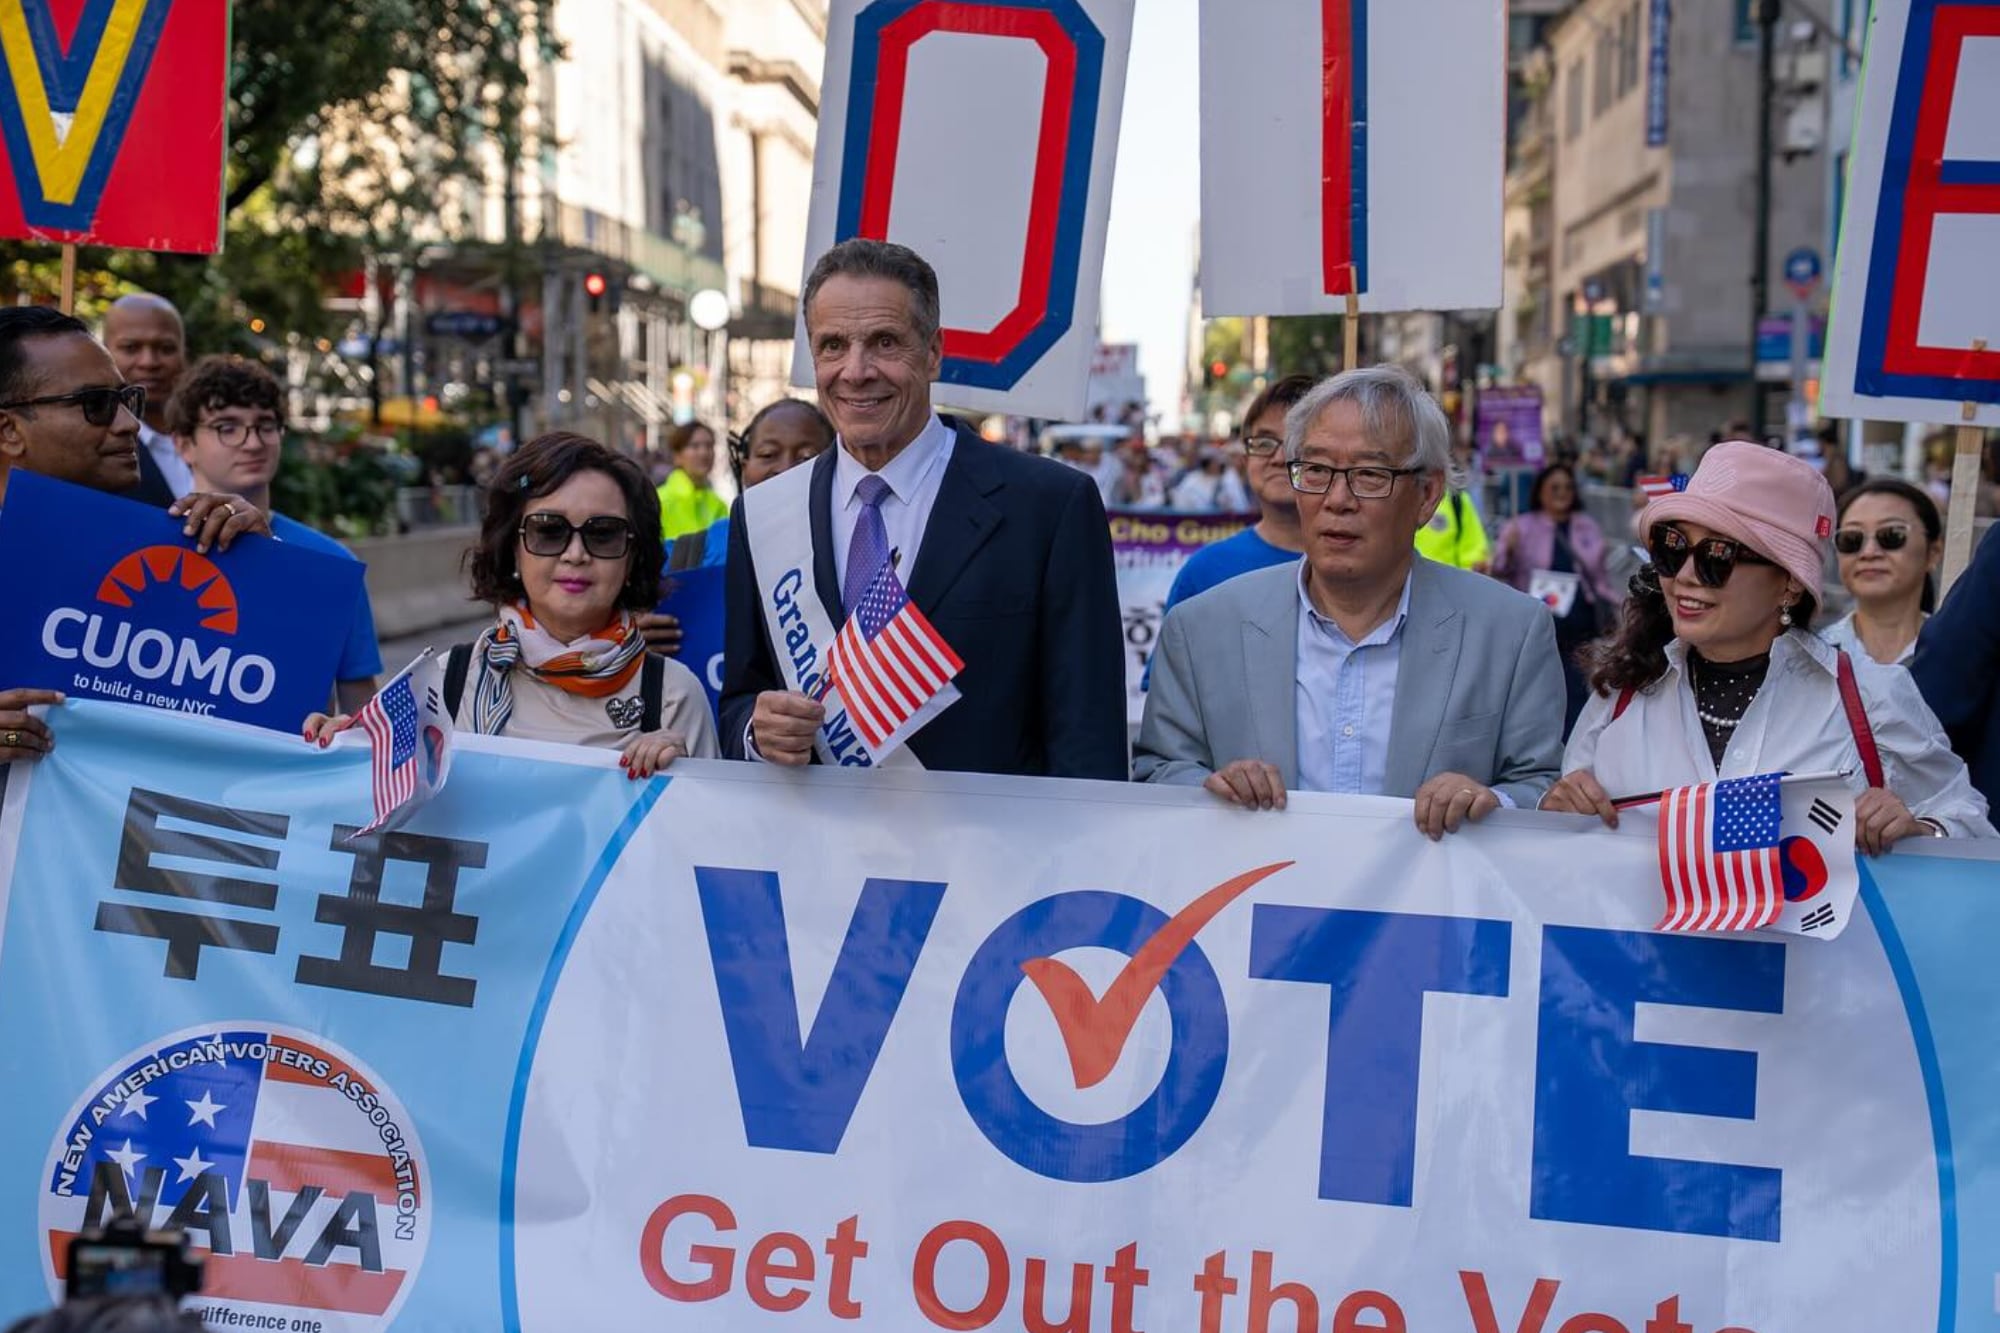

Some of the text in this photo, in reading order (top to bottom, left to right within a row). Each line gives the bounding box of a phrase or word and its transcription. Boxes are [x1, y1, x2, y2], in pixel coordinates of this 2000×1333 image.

[42, 607, 276, 704] CUOMO
[73, 673, 216, 717] to build a new NYC
[93, 786, 490, 1009] 투표
[694, 864, 1786, 1243] VOTE
[56, 1042, 417, 1241] NEW AMERICAN VOTERS ASSOCIATION
[82, 1161, 385, 1274] NAVA
[639, 1193, 869, 1320] Get
[912, 1219, 1149, 1333] Out
[1194, 1249, 1407, 1333] the
[199, 1308, 287, 1330] difference
[291, 1319, 323, 1333] one
